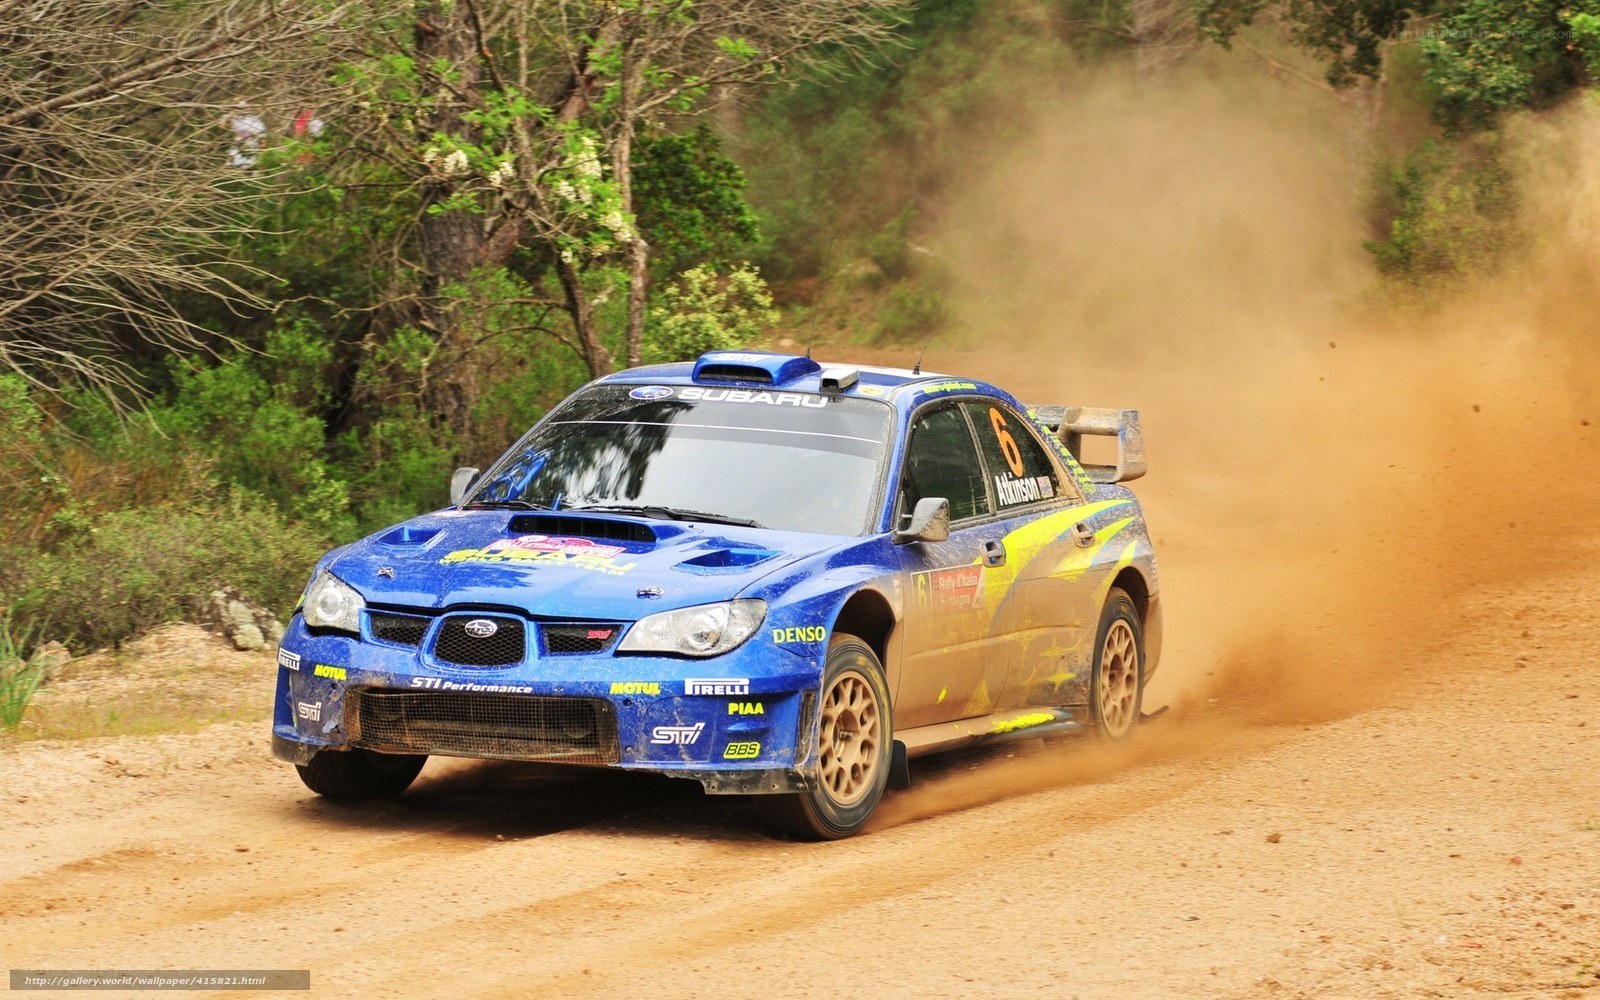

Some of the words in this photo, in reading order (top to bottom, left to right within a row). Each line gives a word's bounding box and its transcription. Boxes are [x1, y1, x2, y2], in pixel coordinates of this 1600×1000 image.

[678, 387, 829, 408] SUBARU
[990, 407, 1024, 478] 6
[995, 472, 1041, 506] Atkinson
[772, 625, 827, 643] DENSO
[314, 664, 347, 680] MOTUL
[410, 677, 442, 690] STI
[442, 681, 533, 694] Performance
[609, 682, 661, 695] MOTUL
[684, 678, 749, 696] PIRELLI
[728, 702, 764, 716] PIAA
[725, 743, 759, 757] BBS
